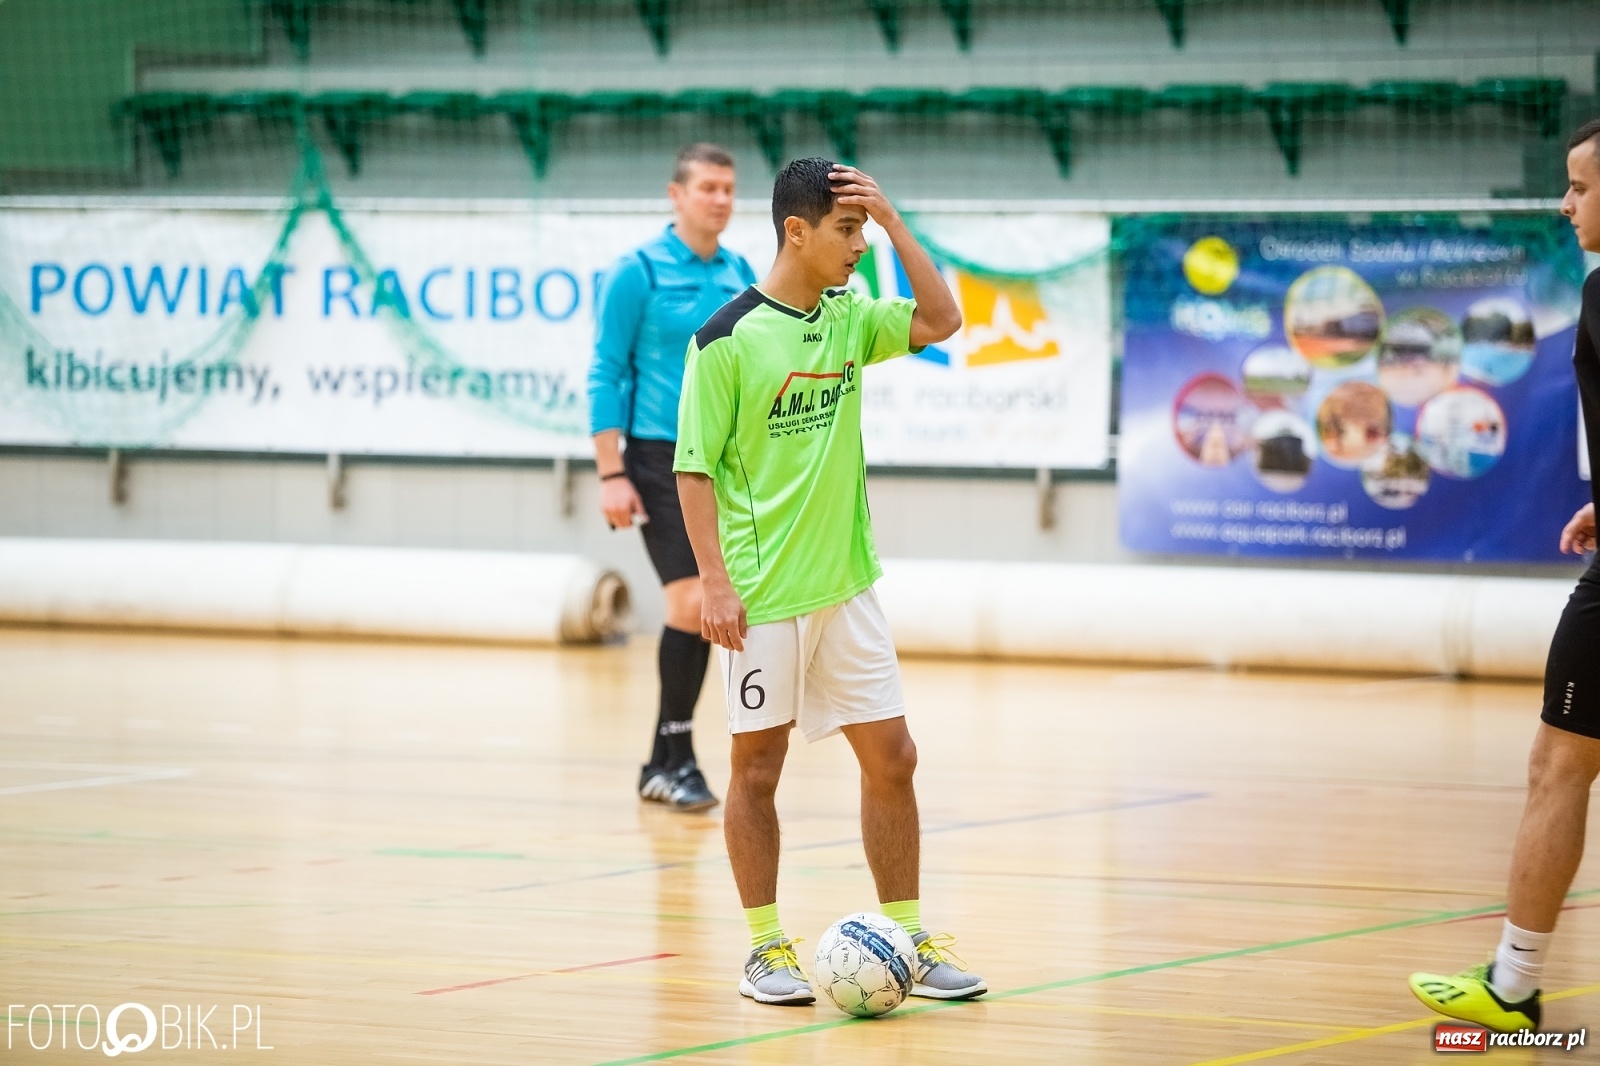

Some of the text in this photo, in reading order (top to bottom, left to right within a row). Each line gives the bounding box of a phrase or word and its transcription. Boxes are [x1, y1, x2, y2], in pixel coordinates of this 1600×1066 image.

[30, 262, 296, 318] POWIAT
[803, 333, 822, 342] JAKO
[24, 348, 578, 409] kibicujemy, wspieramy,
[739, 668, 766, 710] 6
[1562, 681, 1575, 715] KIPSTA
